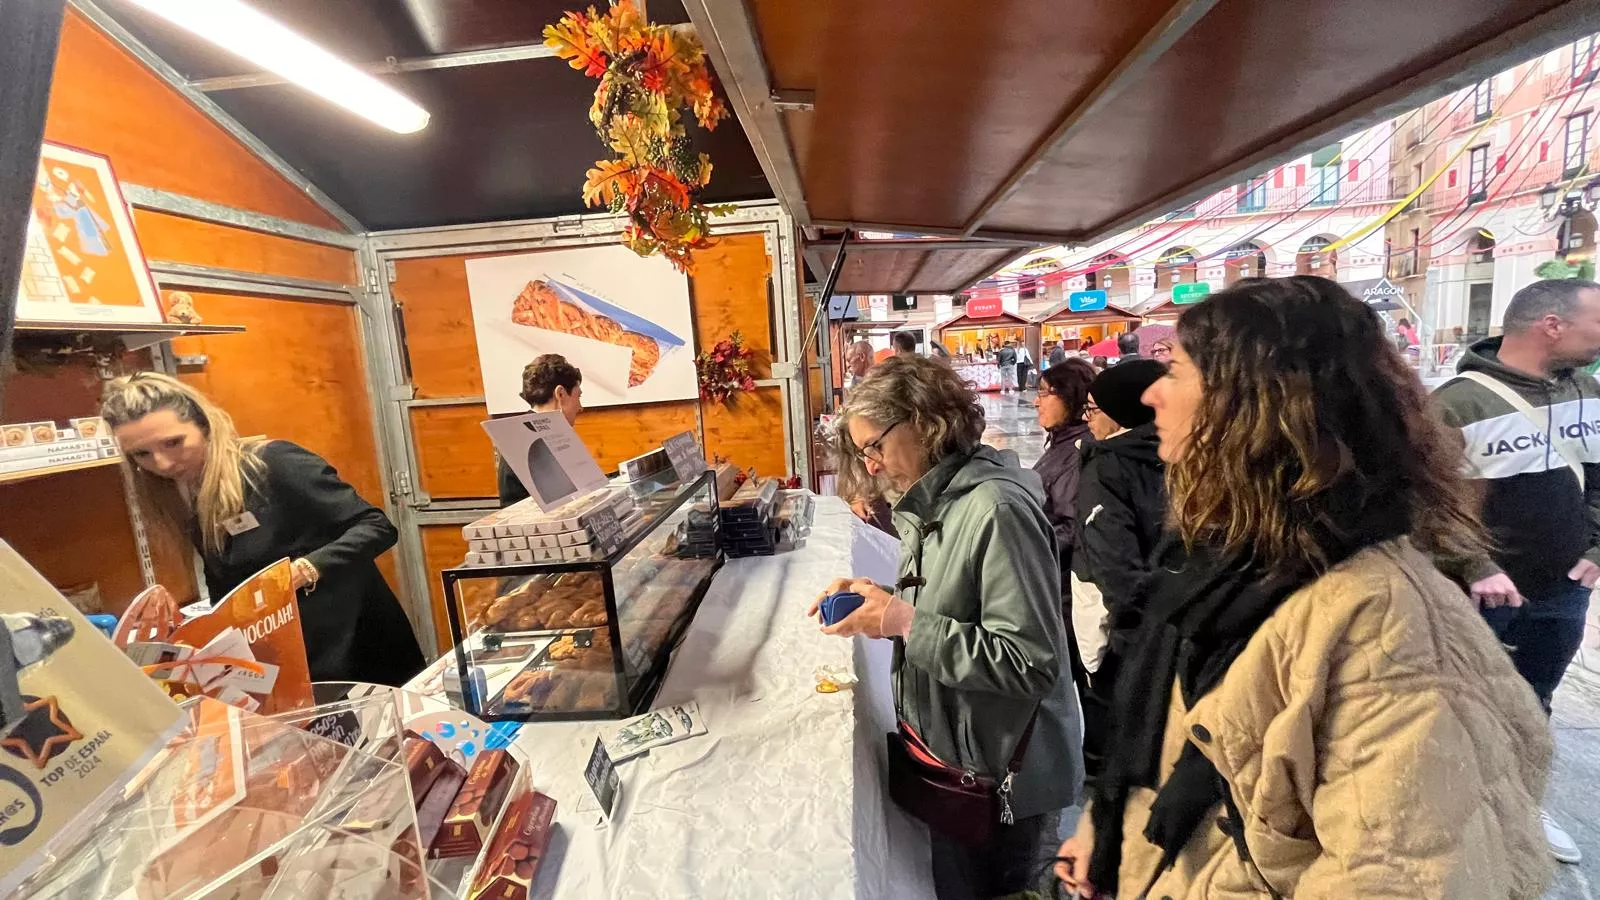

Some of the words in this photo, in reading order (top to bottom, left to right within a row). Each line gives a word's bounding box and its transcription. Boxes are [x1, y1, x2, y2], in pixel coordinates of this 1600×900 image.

[1481, 431, 1545, 457] JACK
[242, 602, 294, 644] OCOLAH!
[40, 766, 65, 787] TOP
[64, 755, 82, 770] DE
[78, 730, 113, 760] ESPAÑA
[73, 755, 103, 779] 2024
[0, 798, 26, 827] R@S
